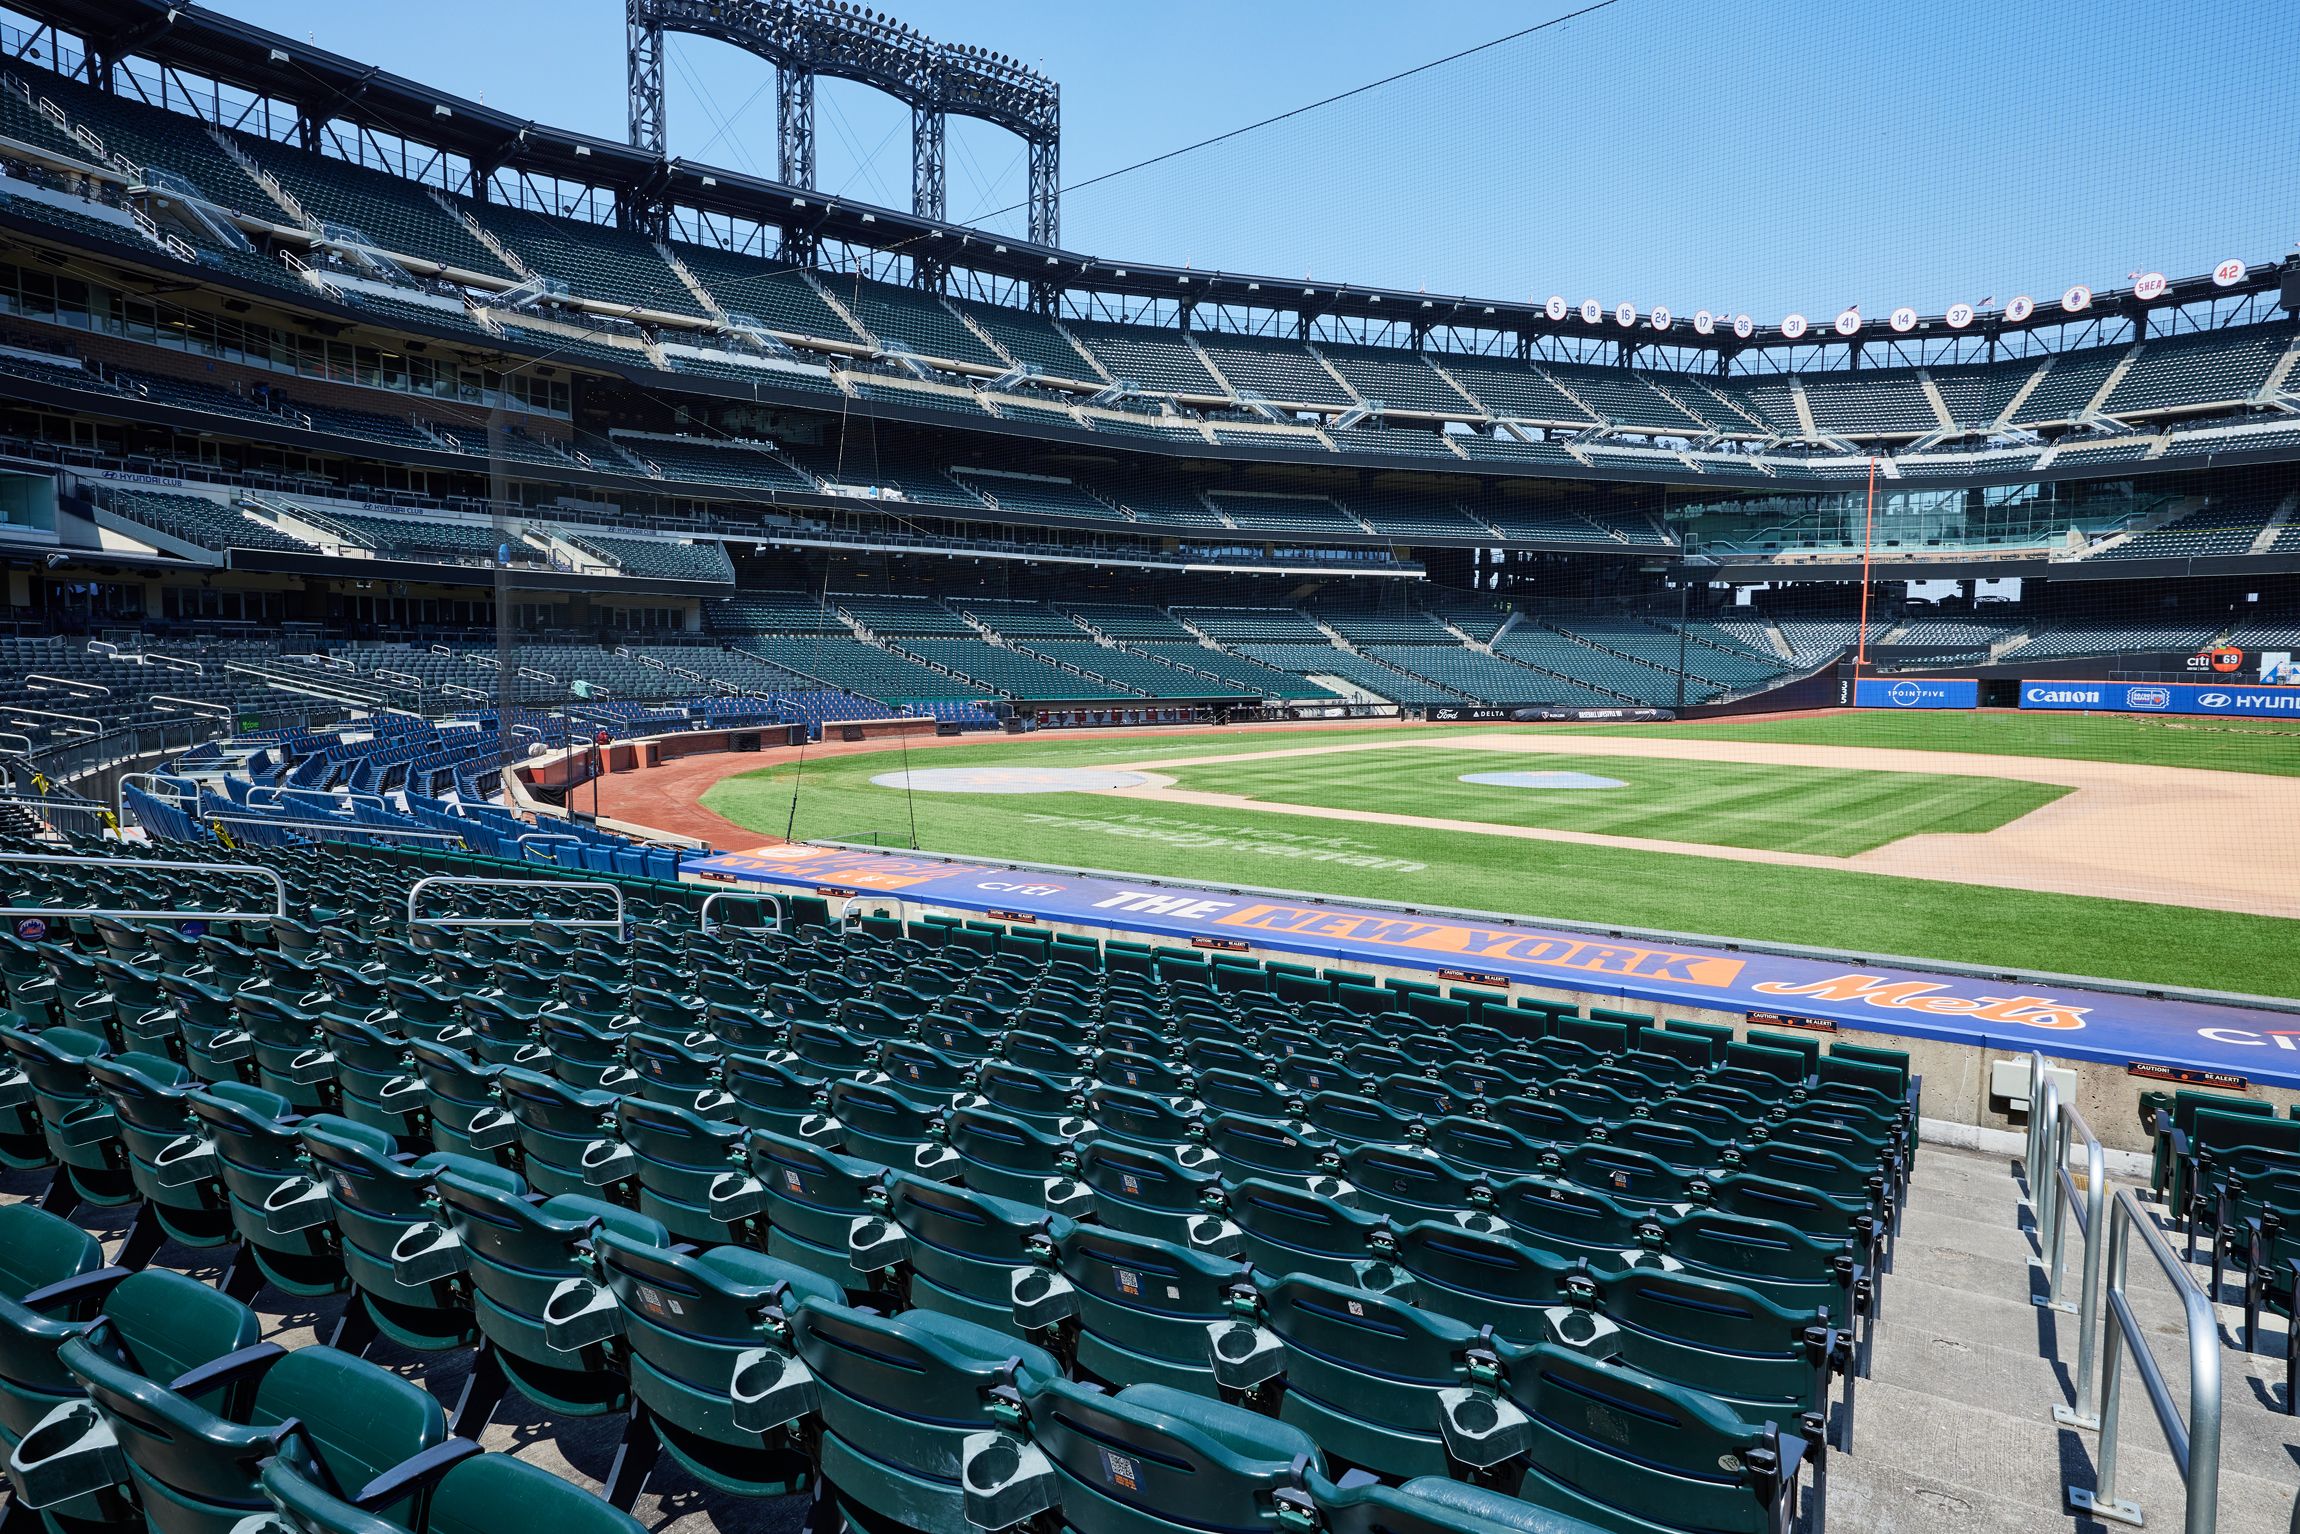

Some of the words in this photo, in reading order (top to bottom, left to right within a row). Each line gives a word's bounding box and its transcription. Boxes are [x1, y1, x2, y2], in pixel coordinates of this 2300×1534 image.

[2218, 265, 2239, 280] 42
[2138, 279, 2162, 293] SHEA
[1553, 302, 1560, 313] 5
[1586, 305, 1596, 317] 18
[1621, 309, 1631, 321] 16
[1654, 312, 1667, 324] 24
[1898, 314, 1909, 325] 14
[1952, 310, 1968, 321] 37
[1699, 316, 1708, 328] 17
[1738, 320, 1749, 331] 36
[1788, 320, 1800, 331] 31
[1842, 317, 1854, 328] 41
[119, 472, 161, 485] HYUNDAI
[162, 479, 183, 487] CLUB
[374, 504, 406, 514] HYUNDAI
[2187, 654, 2210, 666] citi
[2222, 654, 2238, 664] 69
[1840, 680, 1848, 704] 335
[1887, 690, 1945, 698] 1POINTFIVE
[2026, 688, 2100, 703] Canon
[1436, 708, 1459, 720] Ford
[976, 881, 1066, 896] citi
[1091, 890, 1238, 919] THE
[1247, 905, 1442, 944] NEW
[1461, 930, 1711, 981] YORK
[1751, 974, 2095, 1031] Mets
[1753, 1012, 1779, 1020] CAUTION!
[1814, 1019, 1832, 1027] ALERT!
[2196, 1026, 2300, 1051] ci
[2137, 1063, 2170, 1073] CAUTION!
[2215, 1074, 2239, 1083] ALERT!
